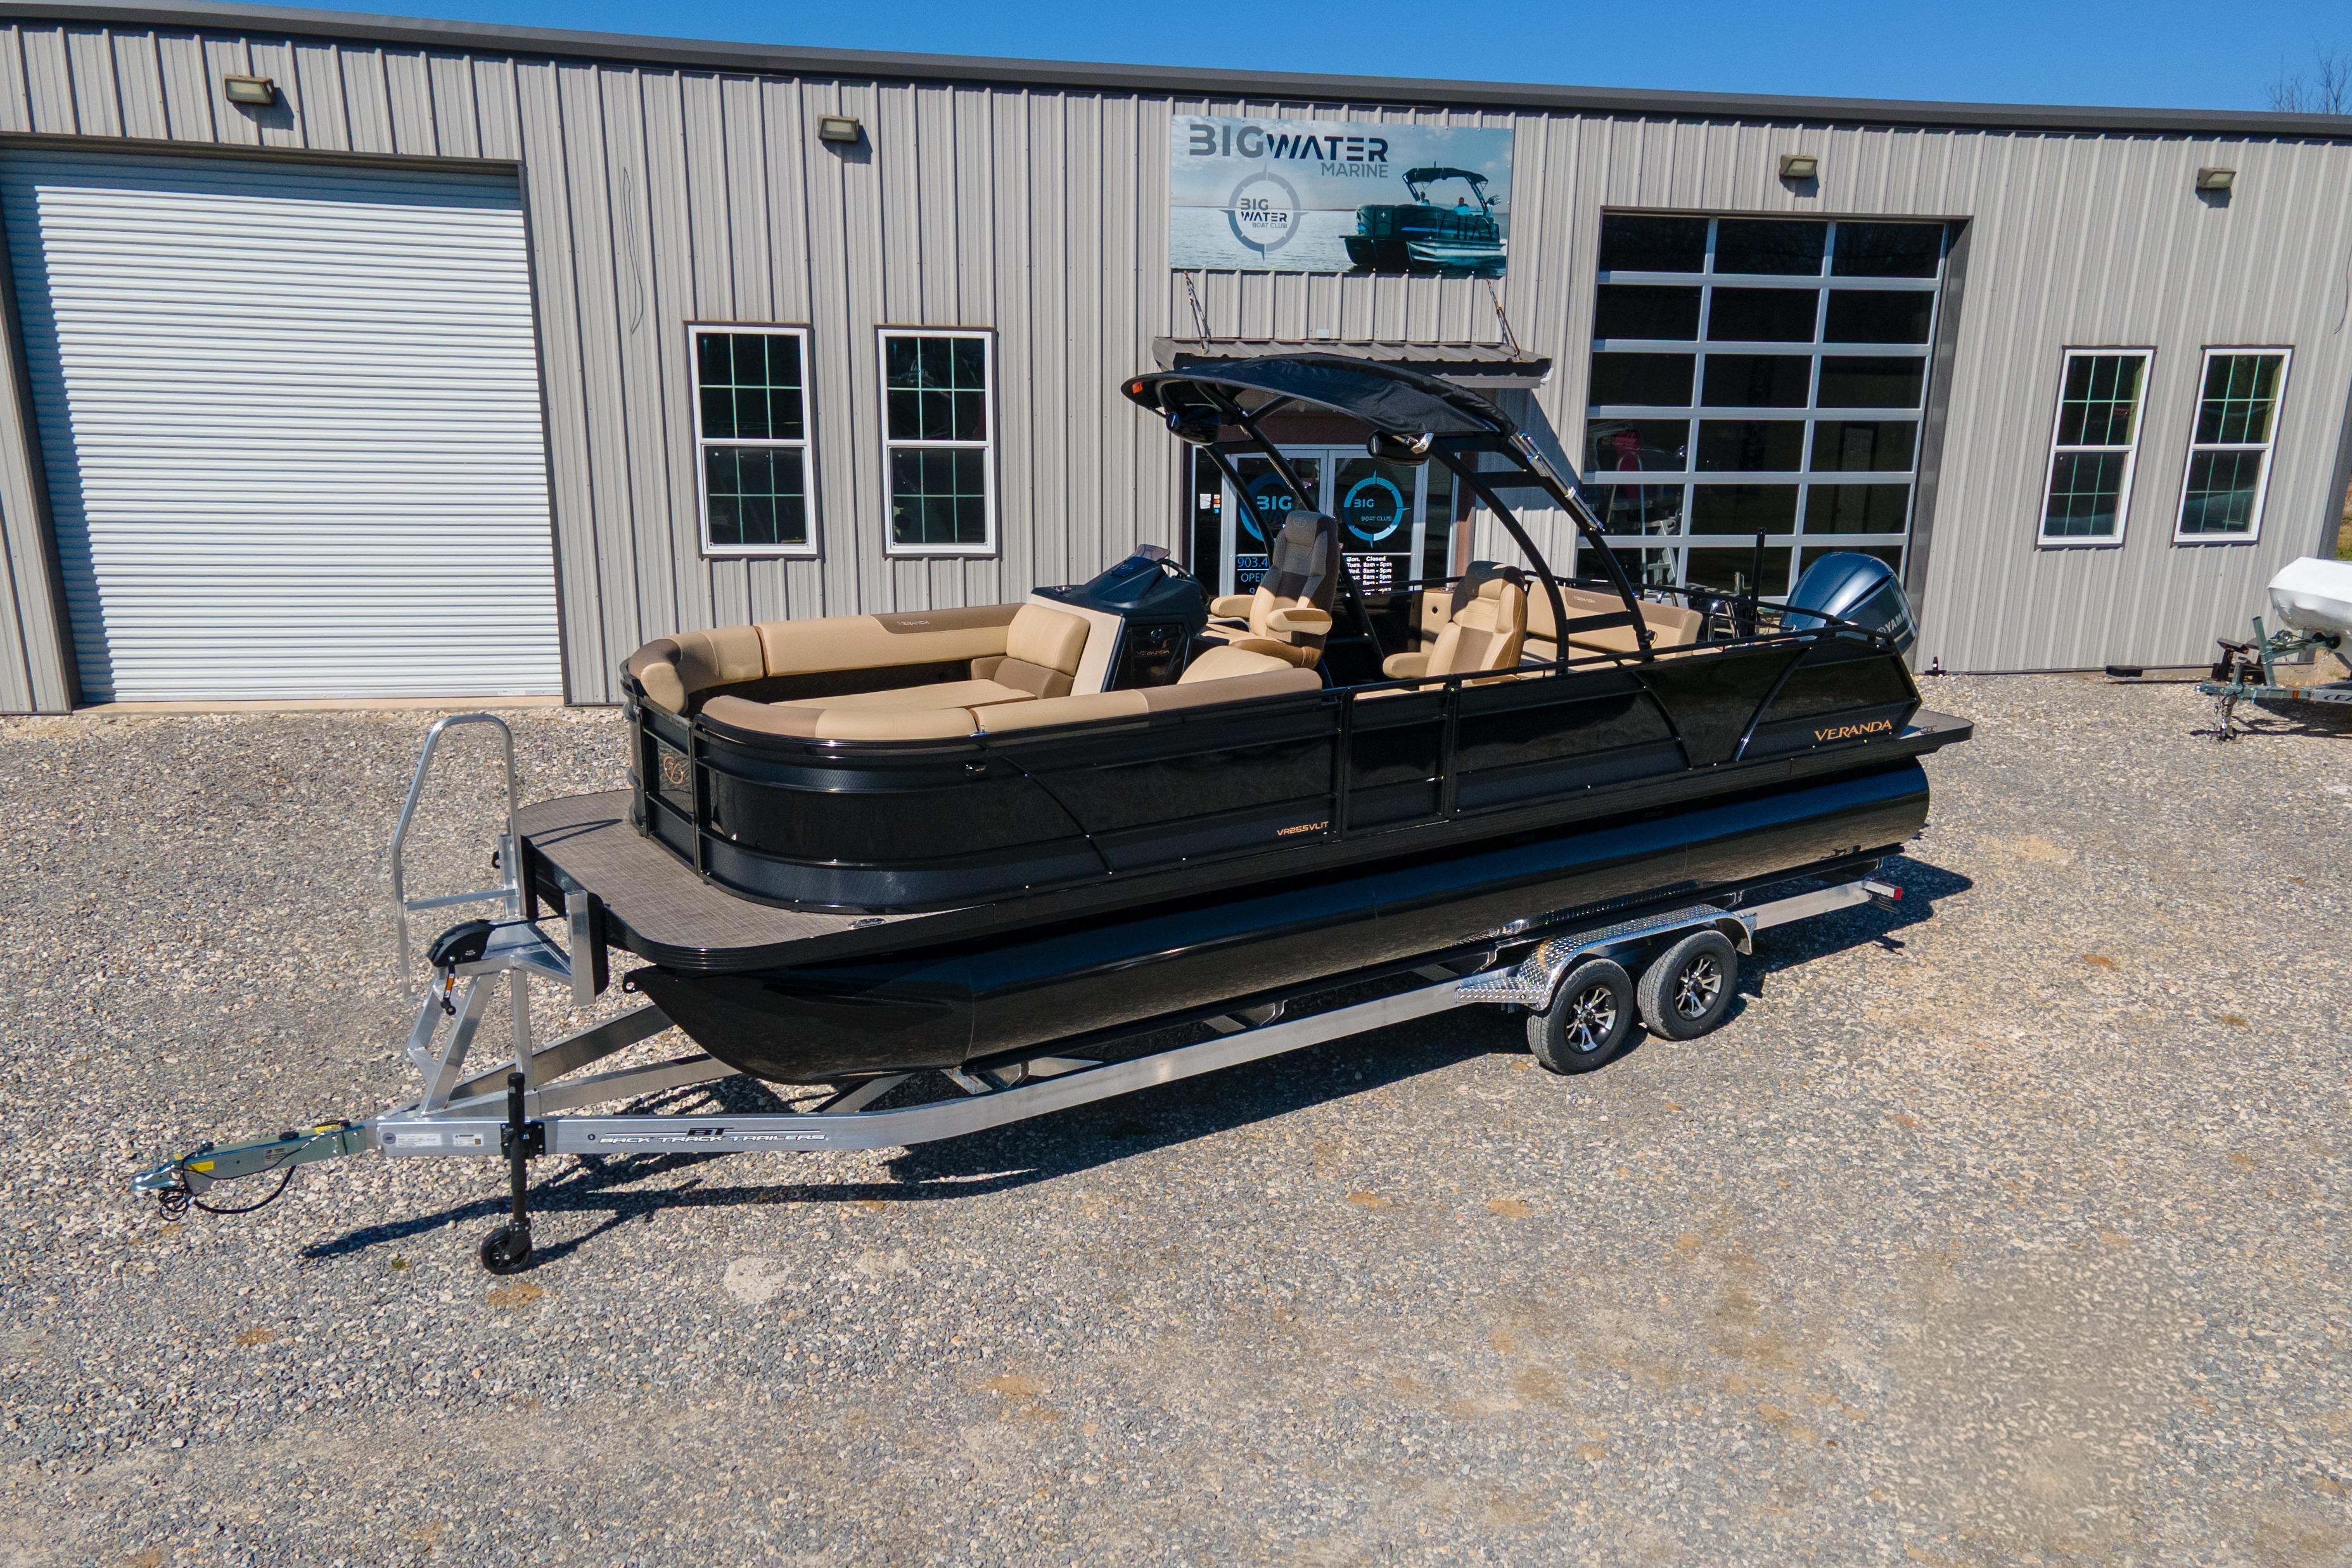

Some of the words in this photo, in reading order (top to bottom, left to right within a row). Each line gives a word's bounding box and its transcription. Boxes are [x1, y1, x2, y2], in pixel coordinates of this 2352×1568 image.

[1320, 162, 1389, 178] MARINE
[1241, 198, 1269, 211] BIG
[1241, 212, 1288, 222] WATER
[1256, 496, 1292, 510] BIG
[1353, 499, 1374, 508] BIG
[1814, 720, 1893, 741] VERANDA
[687, 1127, 734, 1136] BT
